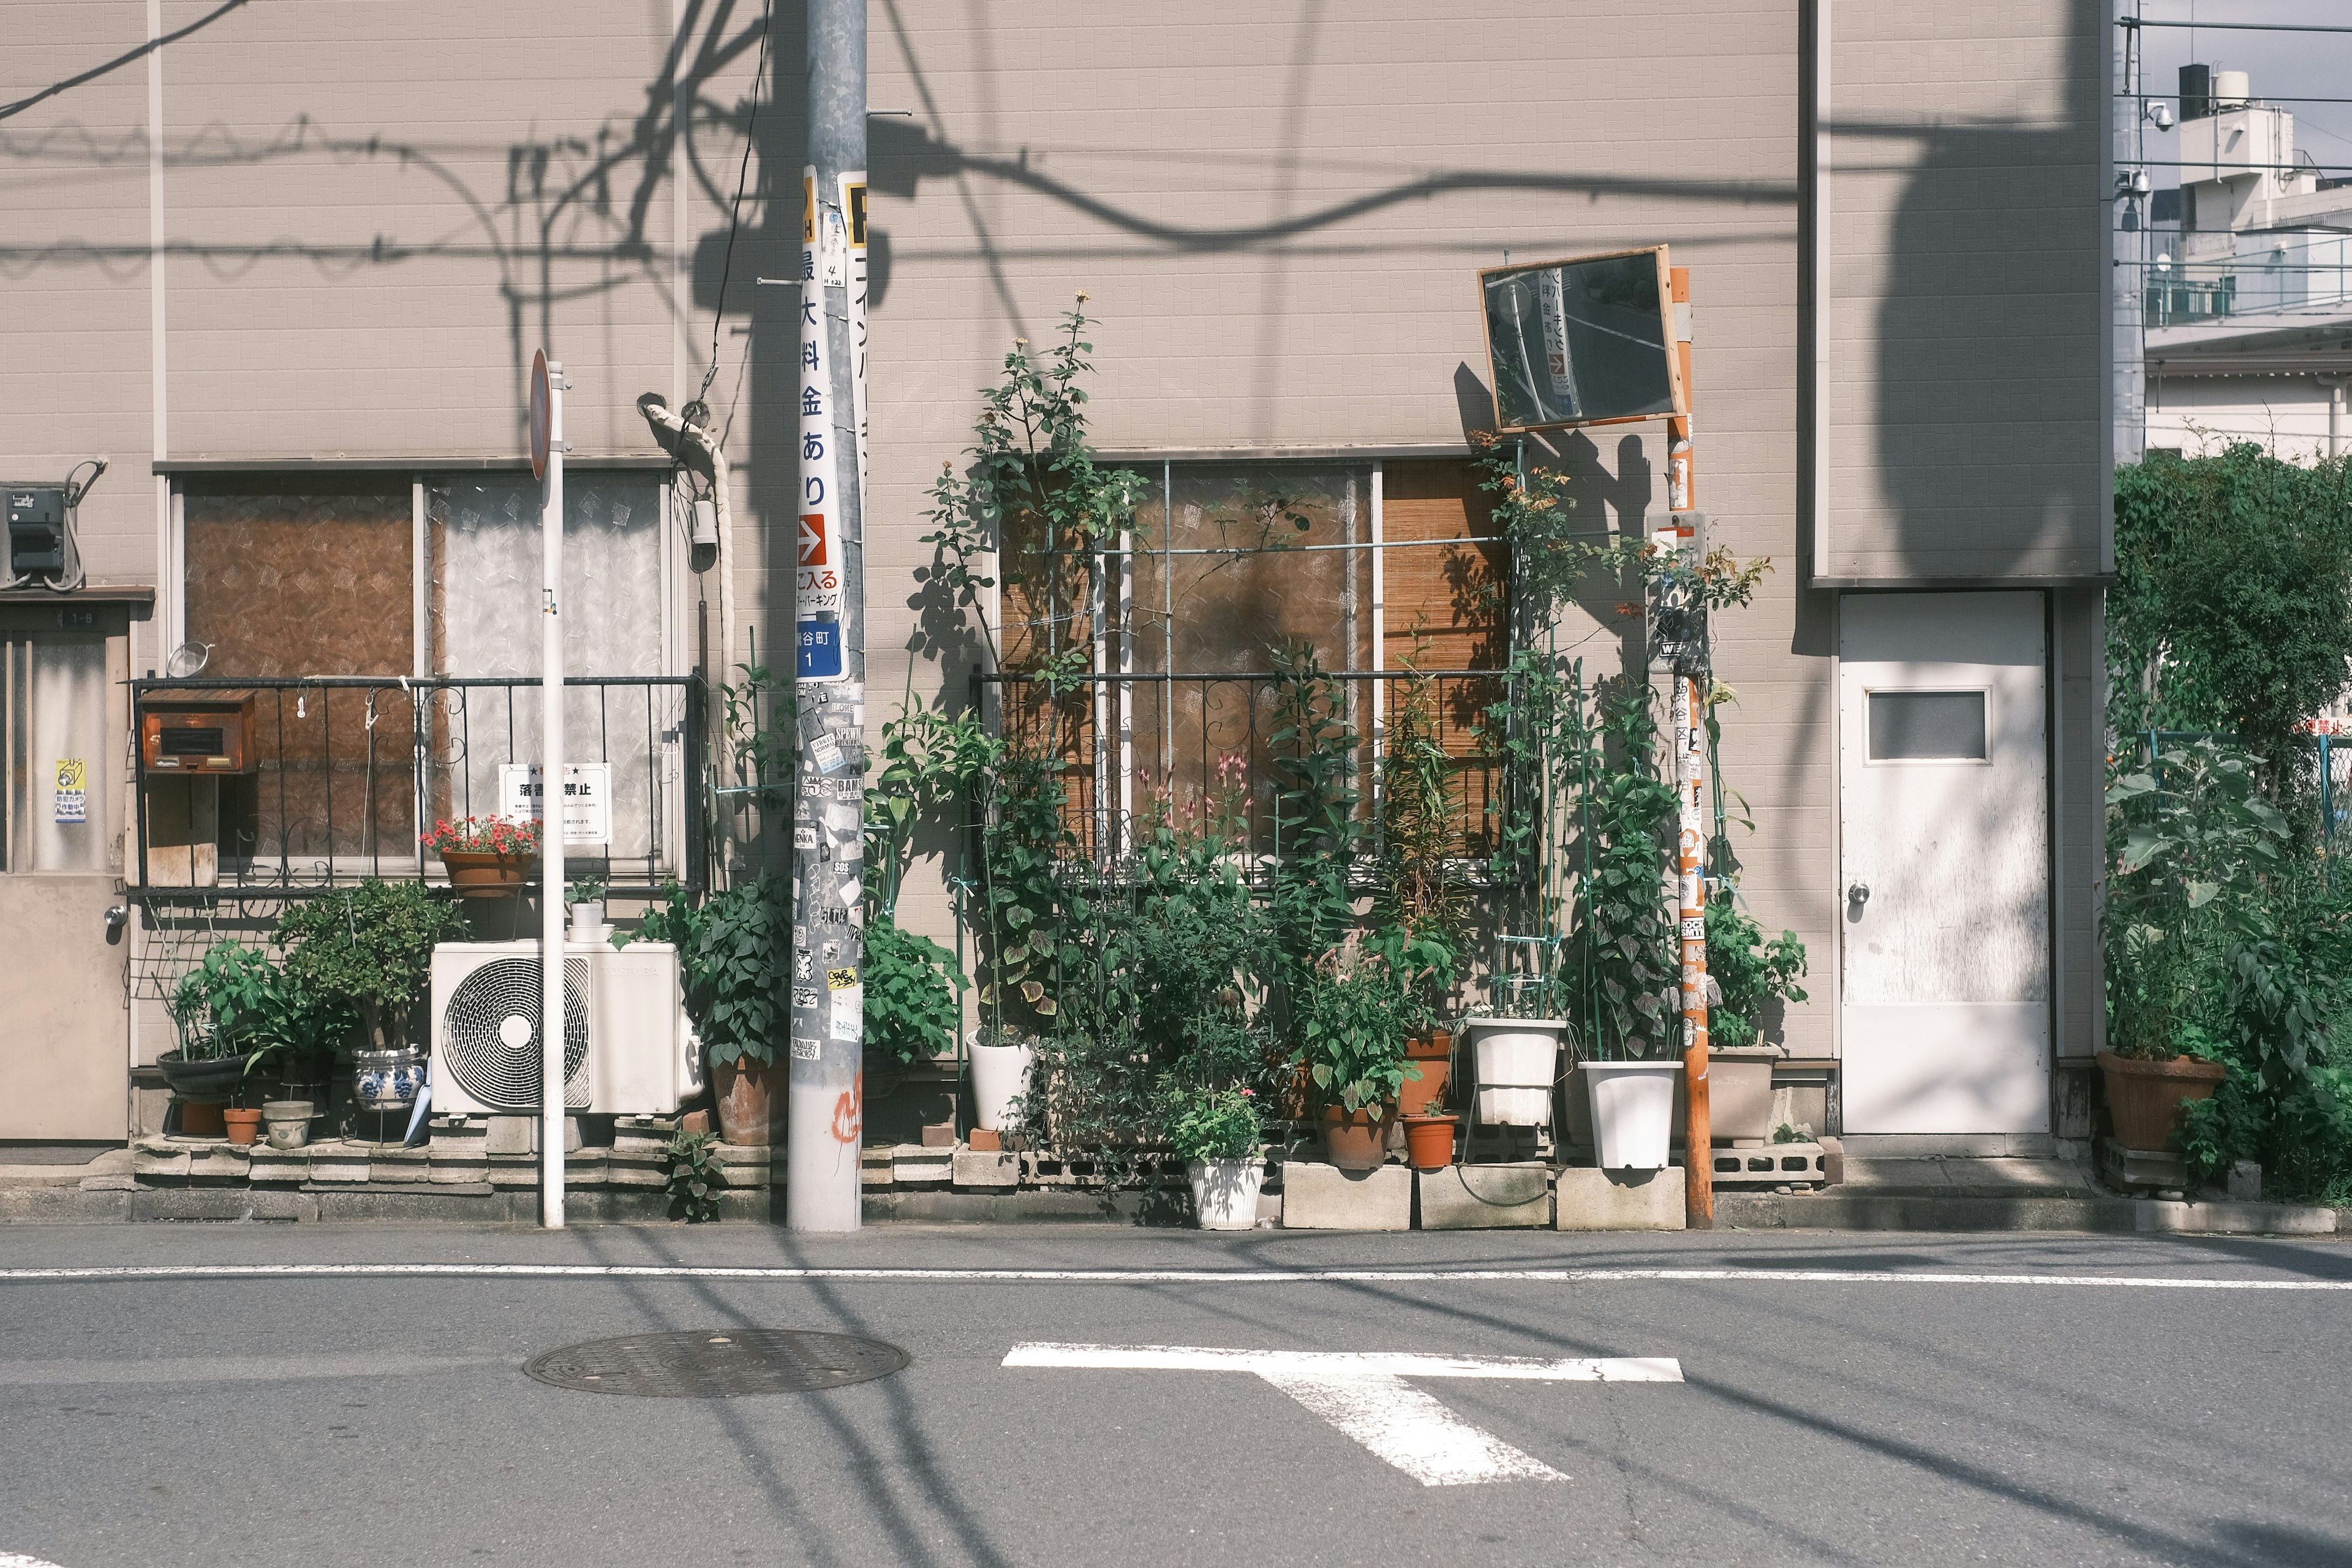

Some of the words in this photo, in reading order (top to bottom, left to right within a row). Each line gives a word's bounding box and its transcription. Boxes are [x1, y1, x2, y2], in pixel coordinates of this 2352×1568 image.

[828, 265, 837, 276] 4
[802, 251, 824, 507] 最大料金あり
[72, 613, 92, 624] 1-8
[805, 652, 812, 667] 1
[519, 783, 592, 797] 落書禁止
[834, 862, 849, 872] SOS
[1681, 921, 1704, 929] ROCK
[601, 966, 659, 977] TOSHIBA
